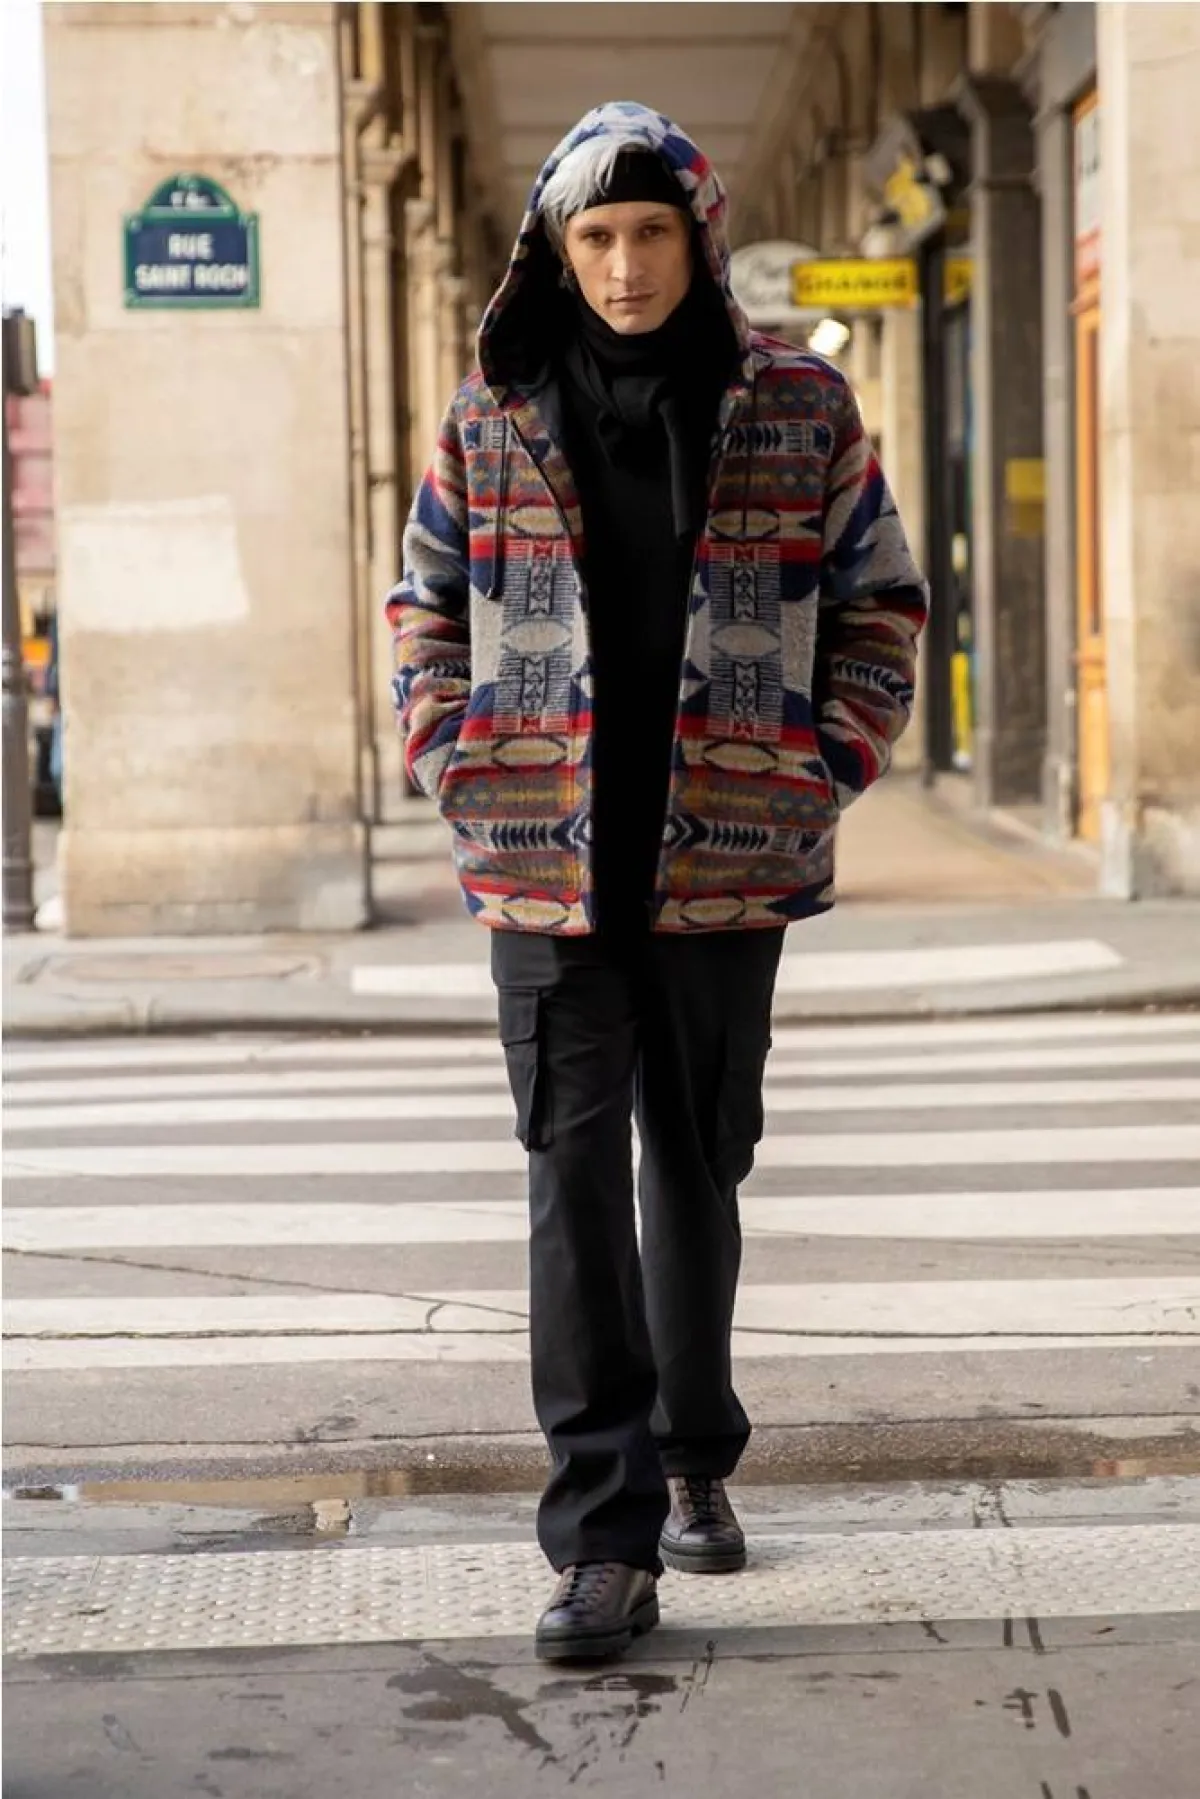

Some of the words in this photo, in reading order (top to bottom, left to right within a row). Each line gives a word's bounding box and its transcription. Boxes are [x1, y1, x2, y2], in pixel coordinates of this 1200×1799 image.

[168, 233, 213, 260] RUE
[135, 264, 191, 290] SAINT
[194, 264, 248, 290] ROCH
